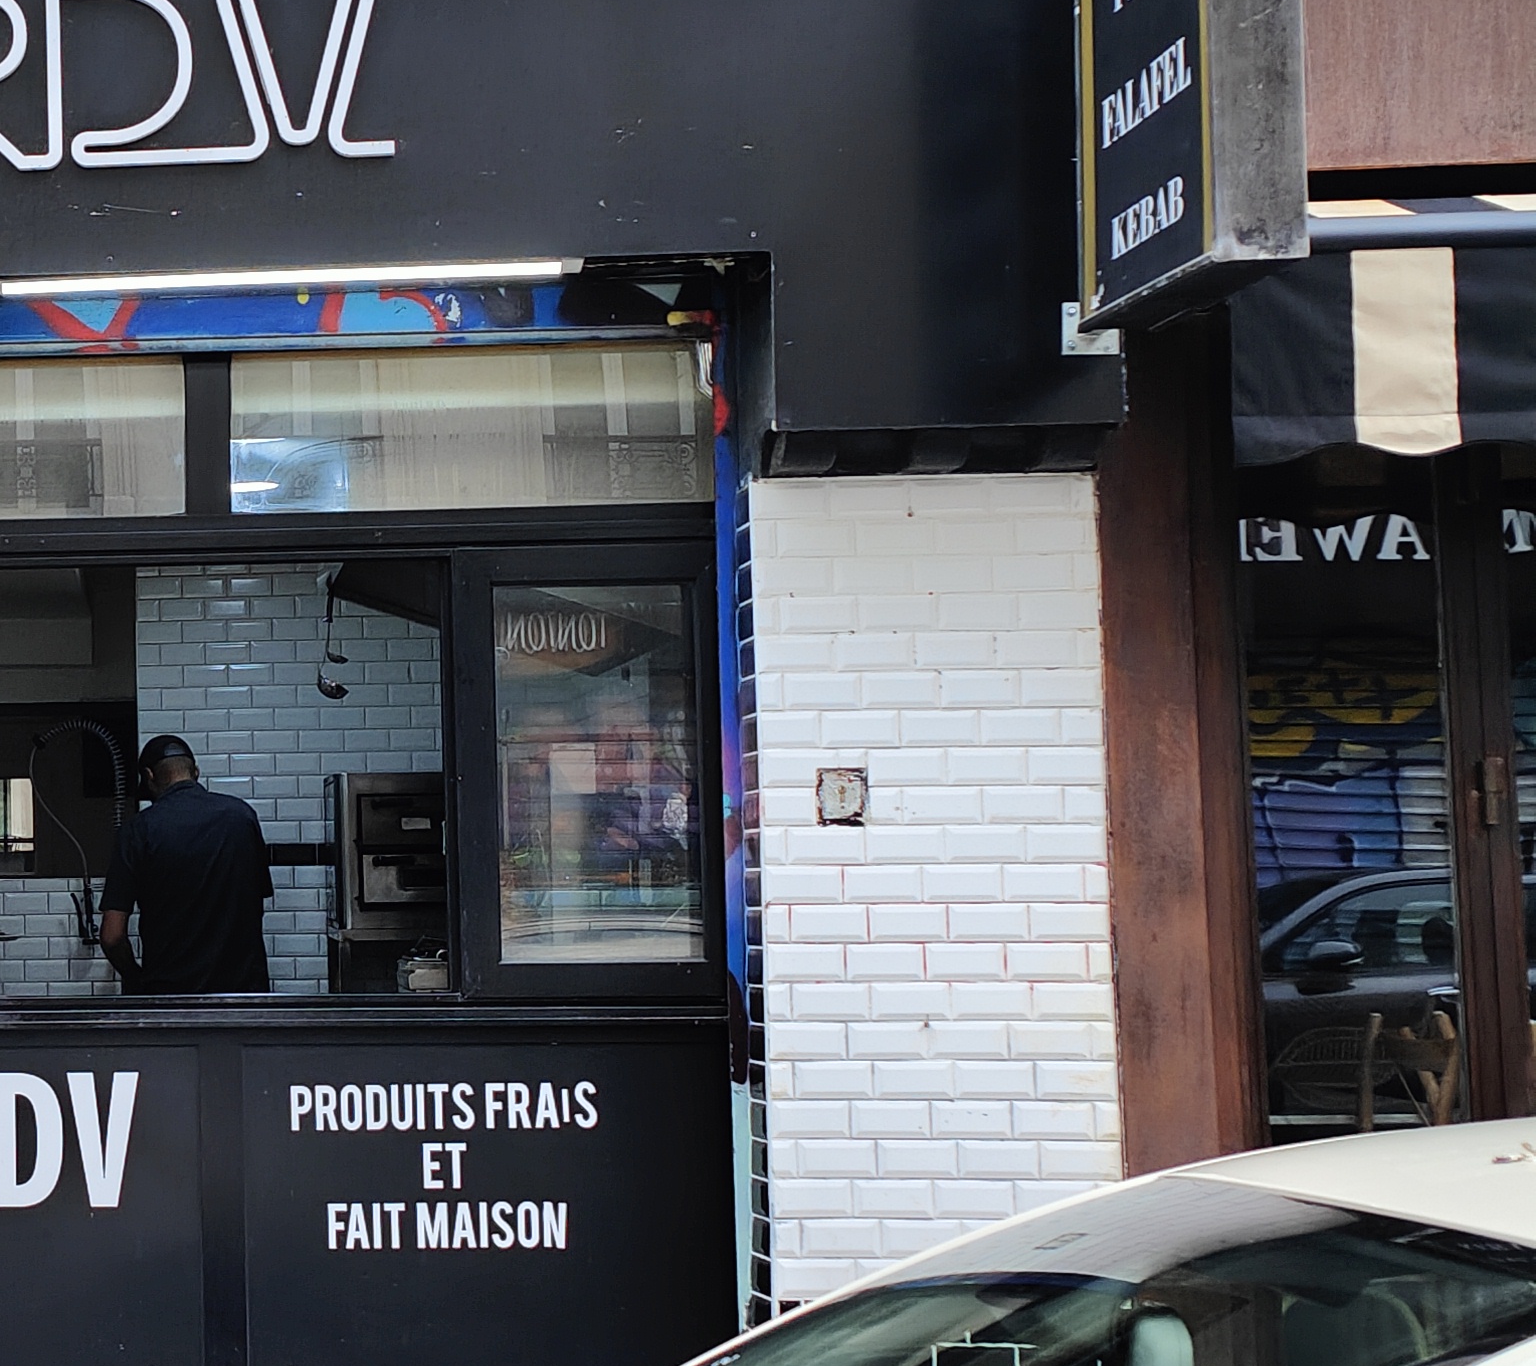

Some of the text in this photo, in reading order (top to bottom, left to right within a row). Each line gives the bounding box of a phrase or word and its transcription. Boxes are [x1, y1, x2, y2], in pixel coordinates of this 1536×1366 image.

[1101, 37, 1192, 150] FALAFEL
[1111, 175, 1185, 261] KEBAB
[289, 1081, 599, 1133] PRODUITS FRAIS
[421, 1142, 469, 1191] ET
[325, 1201, 567, 1250] FAIT MAISON
